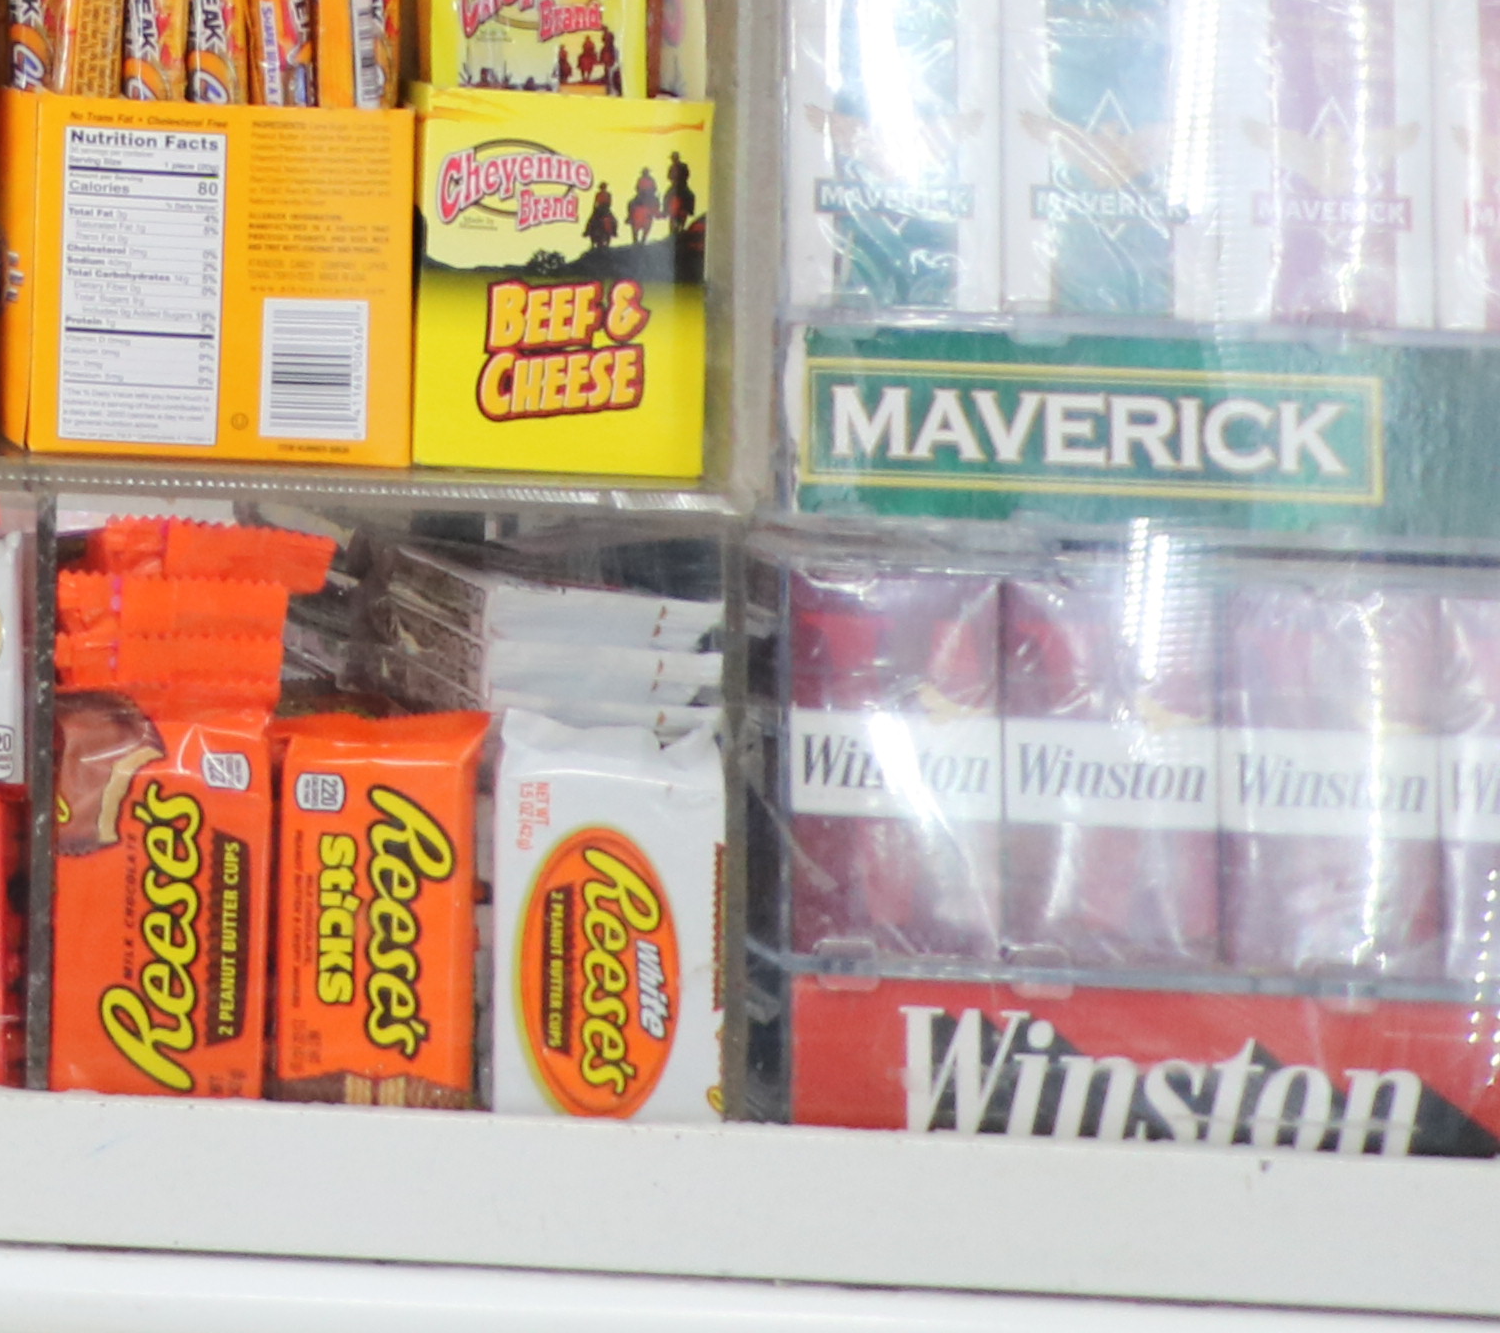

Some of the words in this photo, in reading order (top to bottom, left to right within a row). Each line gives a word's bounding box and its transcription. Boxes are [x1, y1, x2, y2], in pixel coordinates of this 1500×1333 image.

[440, 148, 594, 223] Cheyenne
[518, 188, 579, 229] Brand
[488, 284, 599, 347] BEEF
[608, 281, 649, 340] &
[479, 345, 647, 418] CHEESE
[831, 385, 1349, 476] MAVERICK
[101, 785, 201, 1091] Reese's
[368, 785, 452, 1057] Reese's
[900, 1004, 1424, 1156] Winston
